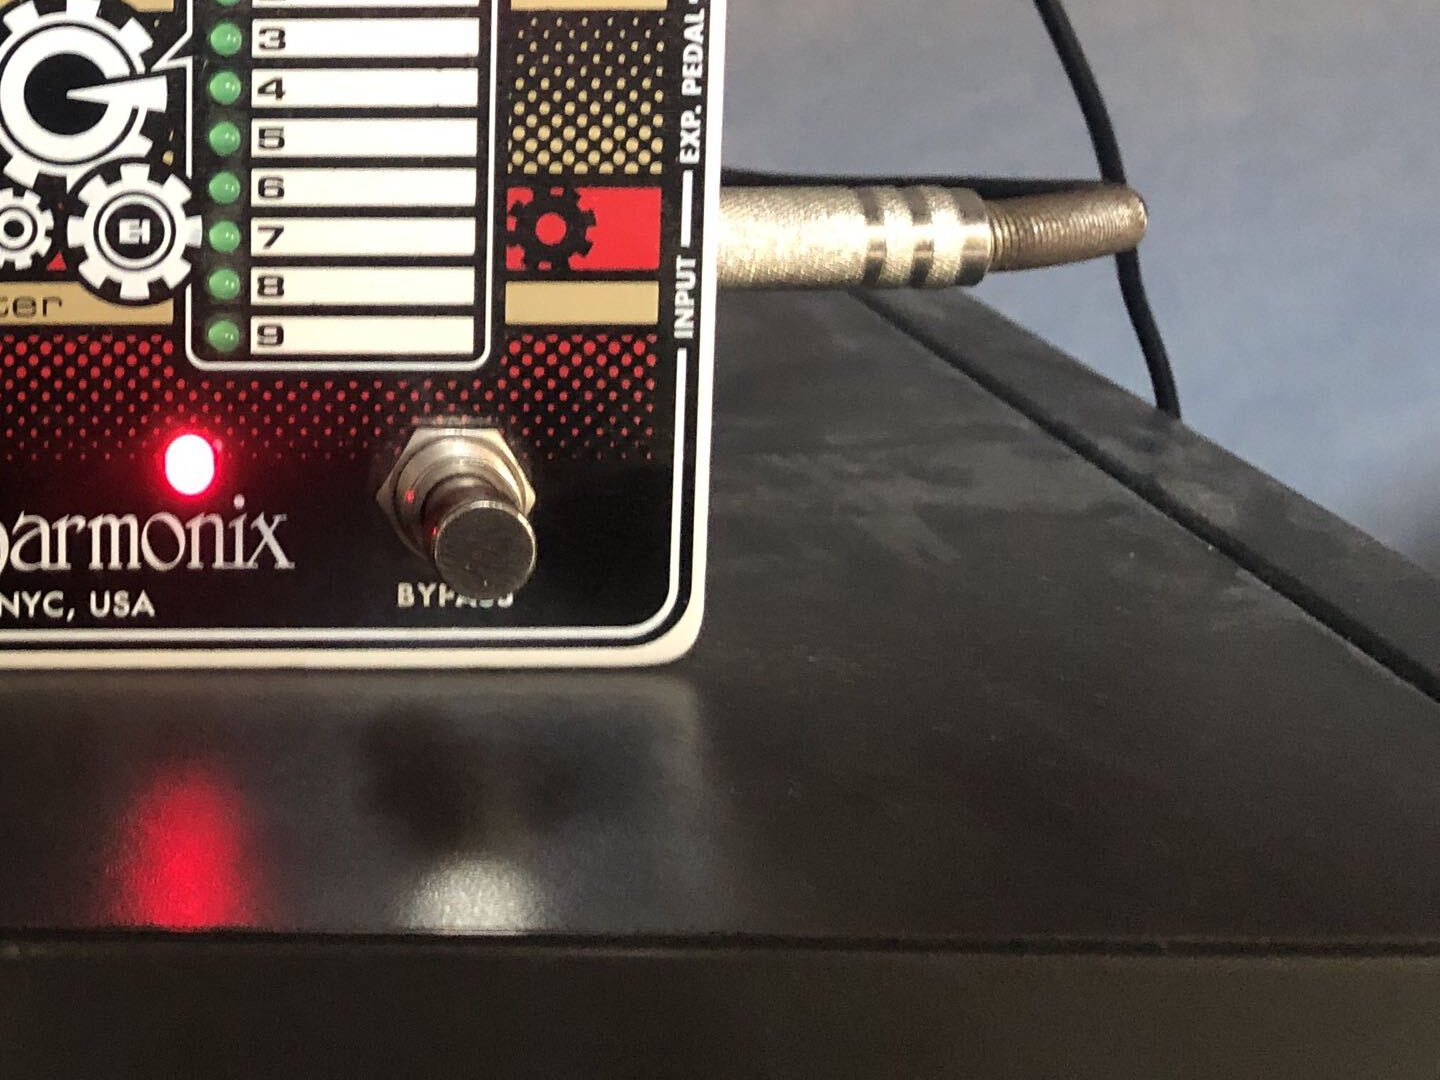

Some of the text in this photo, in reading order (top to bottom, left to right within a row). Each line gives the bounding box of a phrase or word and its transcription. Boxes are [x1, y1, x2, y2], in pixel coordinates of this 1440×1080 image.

[258, 27, 286, 50] 3
[257, 77, 286, 100] 4
[679, 8, 705, 165] EXP. PEDAL
[258, 127, 286, 150] 5
[257, 176, 285, 199] 6
[257, 226, 285, 248] 7
[257, 275, 285, 298] 8
[674, 254, 696, 339] INPUT
[257, 324, 285, 347] 9
[90, 589, 155, 618] USA
